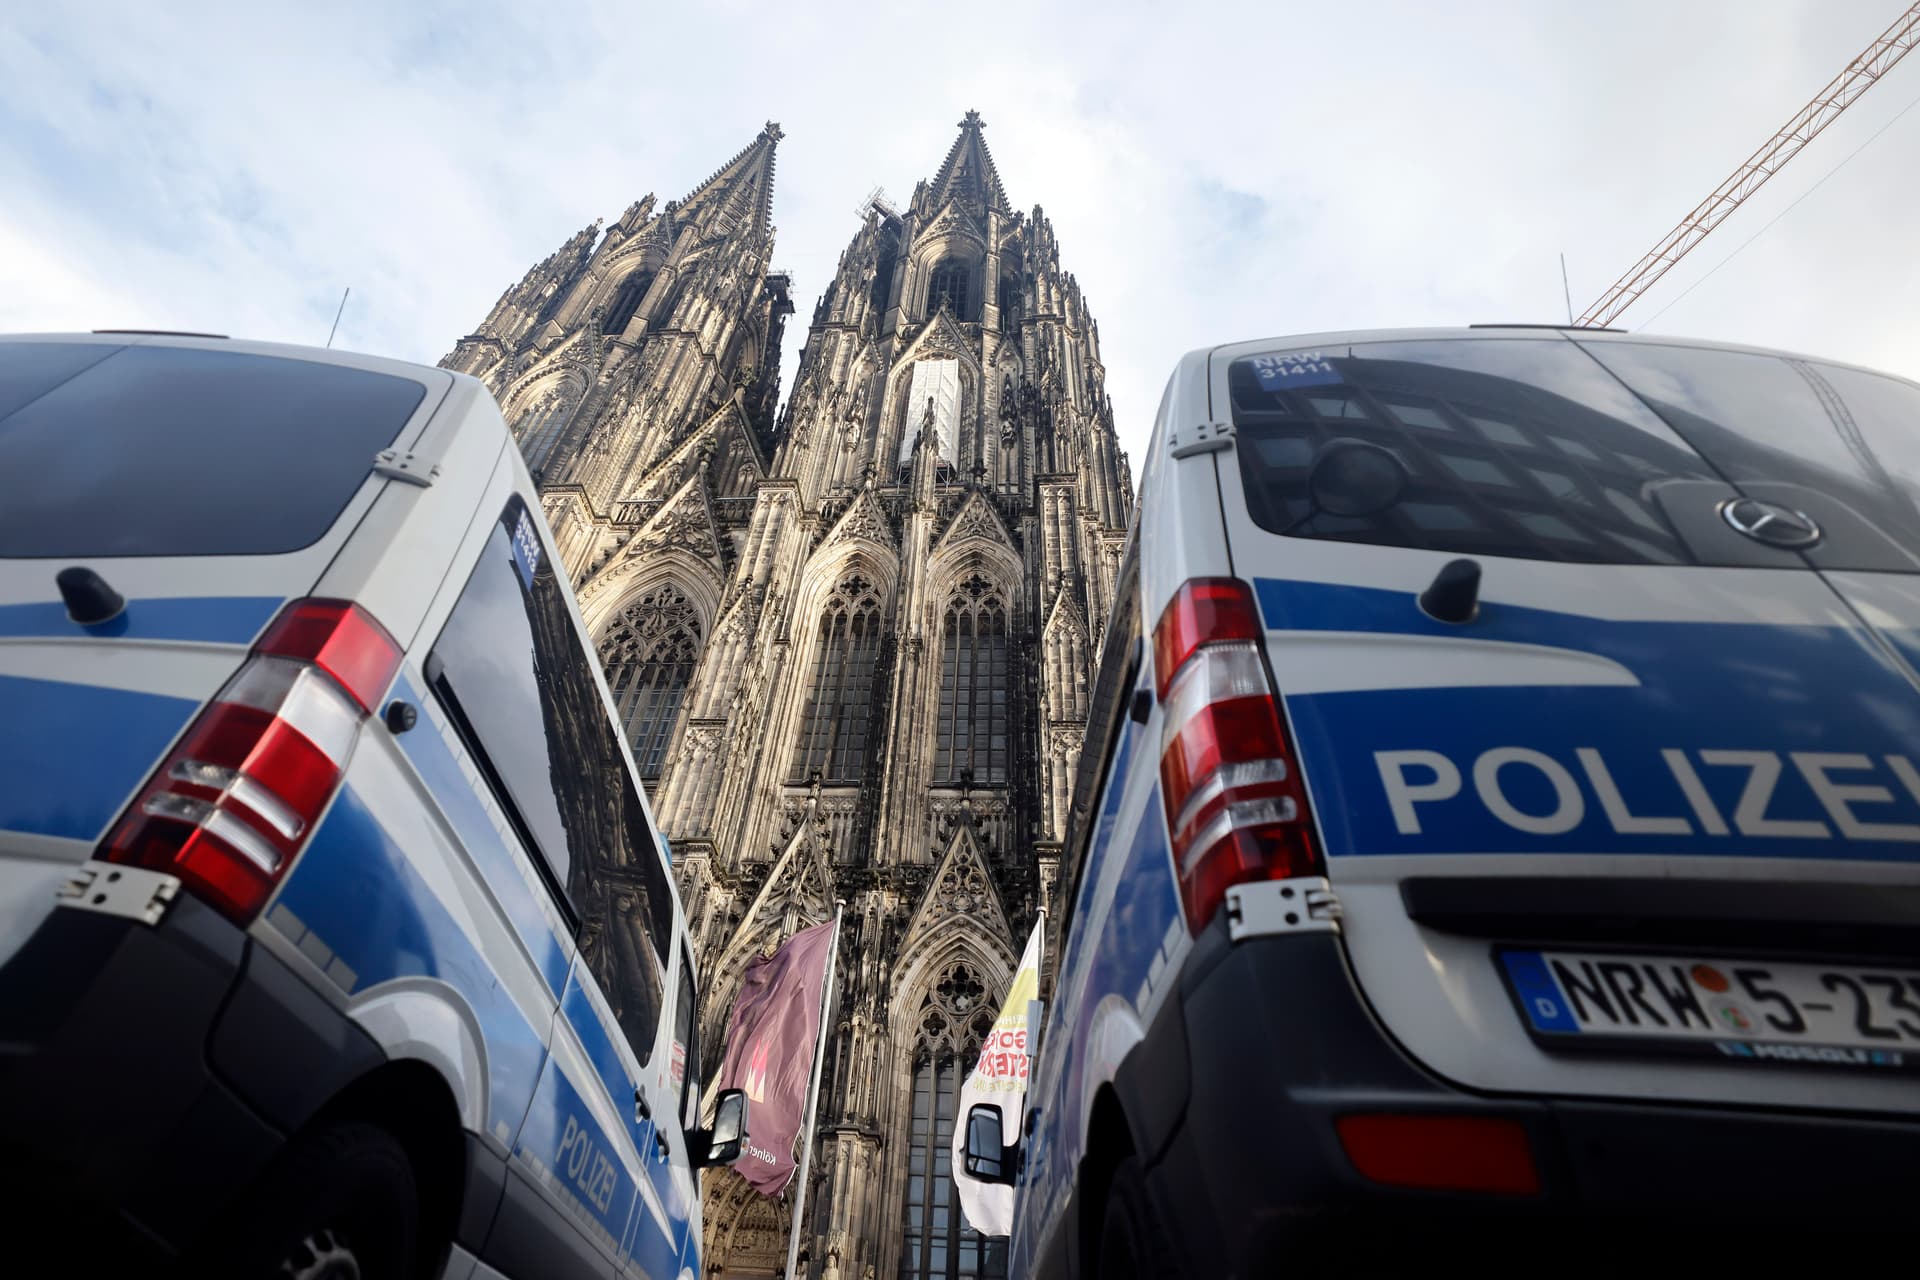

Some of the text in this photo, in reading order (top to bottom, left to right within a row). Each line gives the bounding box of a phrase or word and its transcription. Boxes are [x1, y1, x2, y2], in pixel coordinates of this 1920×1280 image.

[1253, 351, 1321, 369] NRW
[1259, 362, 1333, 379] 31411
[1533, 996, 1559, 1018] D
[1551, 958, 1920, 1041] NRW 5-23
[556, 1113, 618, 1216] POLIZEI
